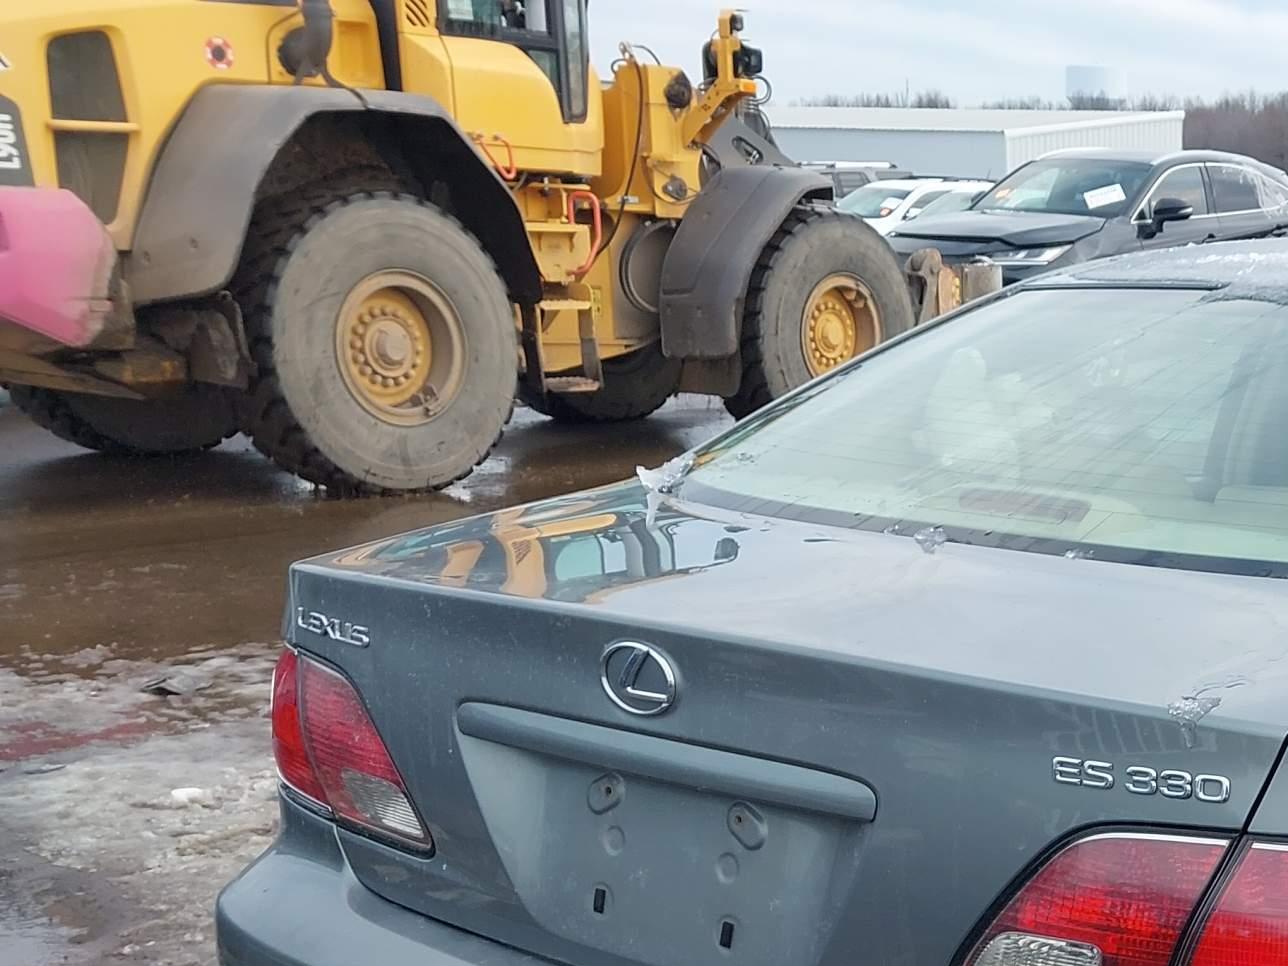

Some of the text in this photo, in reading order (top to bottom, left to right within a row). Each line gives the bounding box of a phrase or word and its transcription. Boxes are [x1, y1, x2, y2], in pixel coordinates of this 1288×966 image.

[297, 606, 370, 648] LEXUS
[1052, 756, 1232, 804] ES 330
